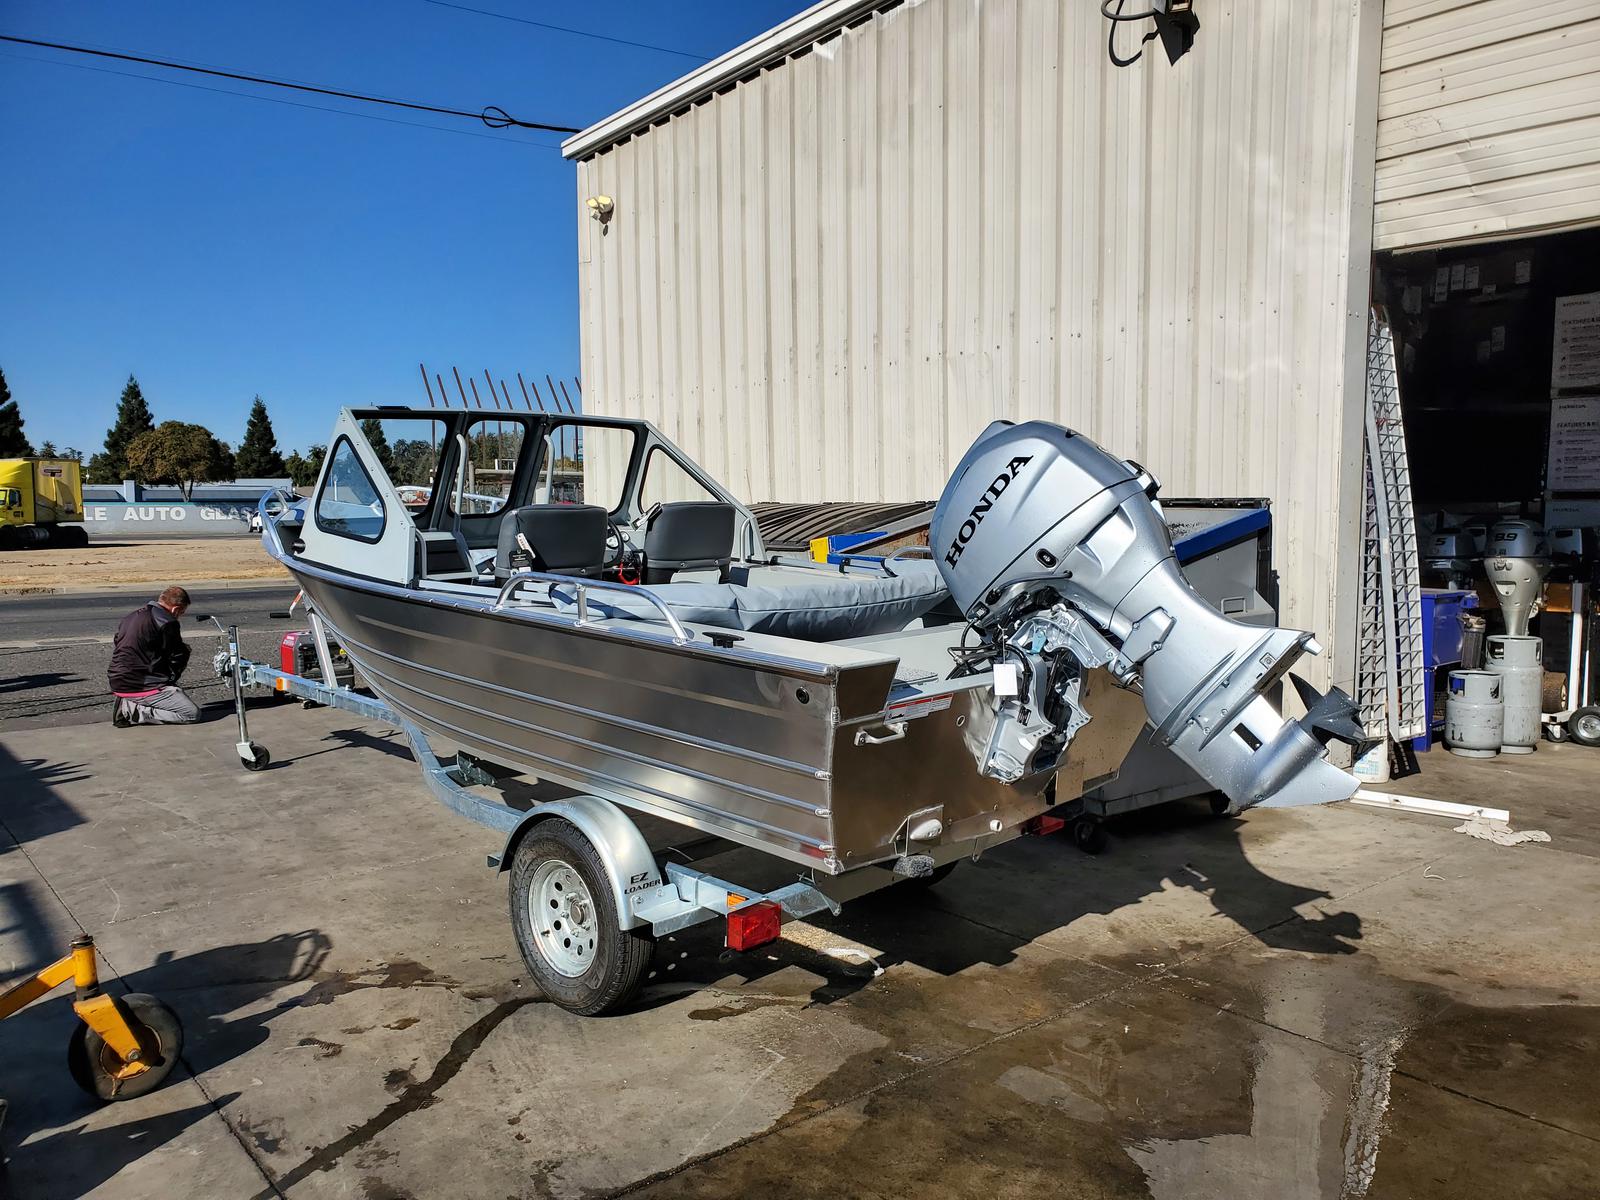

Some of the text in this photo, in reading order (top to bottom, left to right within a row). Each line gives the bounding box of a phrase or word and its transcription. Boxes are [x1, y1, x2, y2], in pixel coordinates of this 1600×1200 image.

[123, 507, 186, 521] AUTO
[944, 454, 1034, 571] HONDA
[1436, 538, 1447, 546] 5
[631, 871, 649, 885] EZ
[624, 879, 661, 895] LOADER
